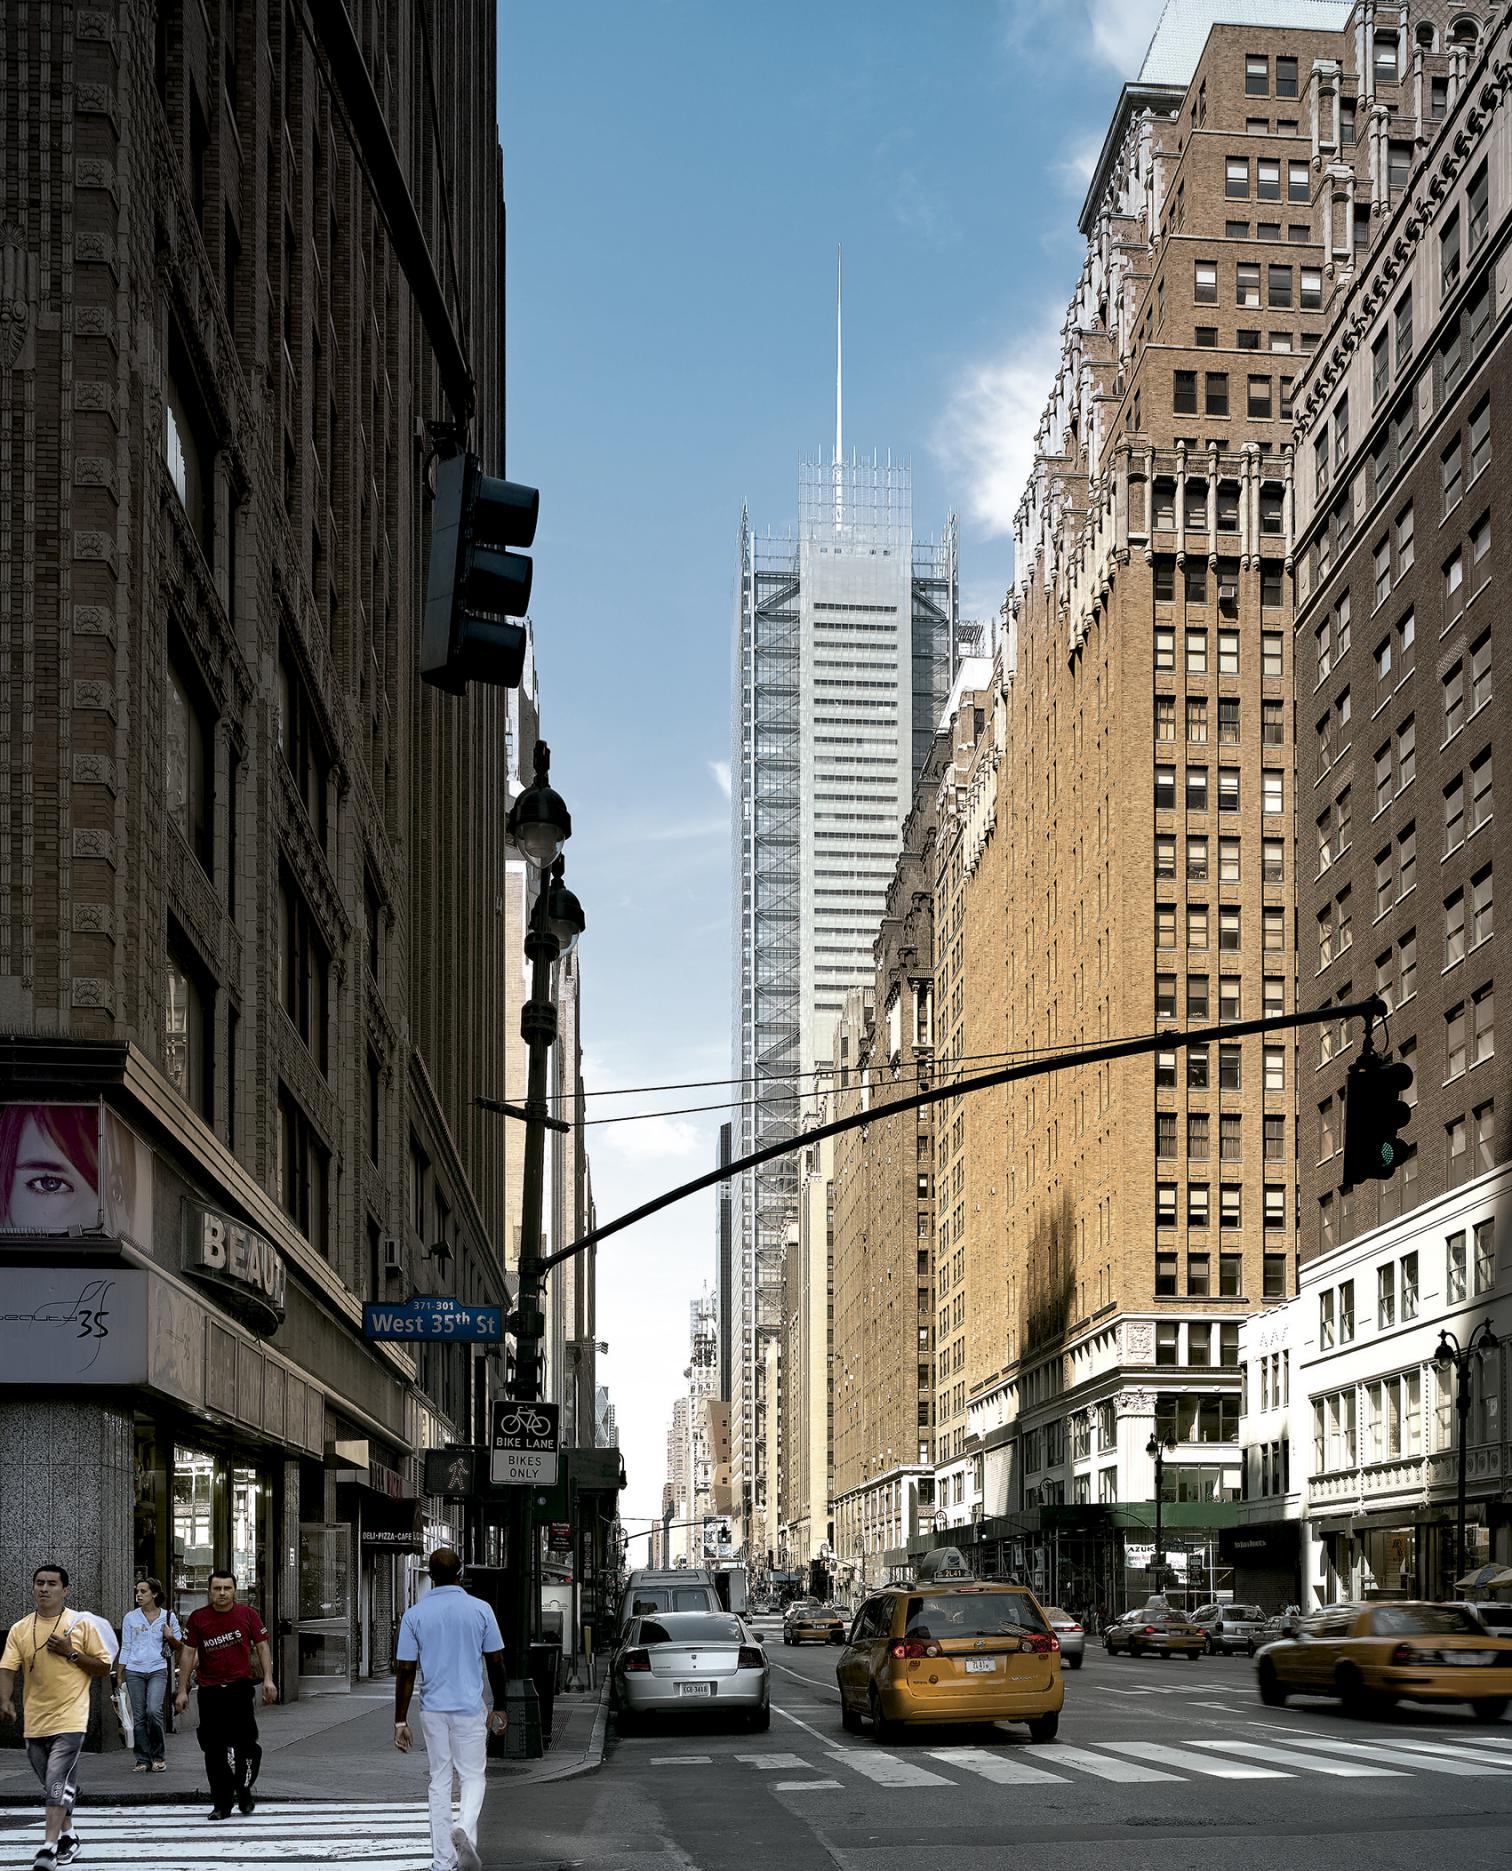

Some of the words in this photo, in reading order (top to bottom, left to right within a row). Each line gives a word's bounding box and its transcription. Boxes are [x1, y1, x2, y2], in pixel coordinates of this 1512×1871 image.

[413, 1301, 454, 1311] 371-301
[76, 1310, 110, 1339] 35
[371, 1313, 424, 1333] West
[431, 1311, 471, 1334] 35th
[476, 1315, 496, 1335] St
[496, 1437, 521, 1448] BIKE
[526, 1438, 555, 1449] LANE
[508, 1455, 542, 1467] BIKES
[509, 1468, 540, 1479] ONLY
